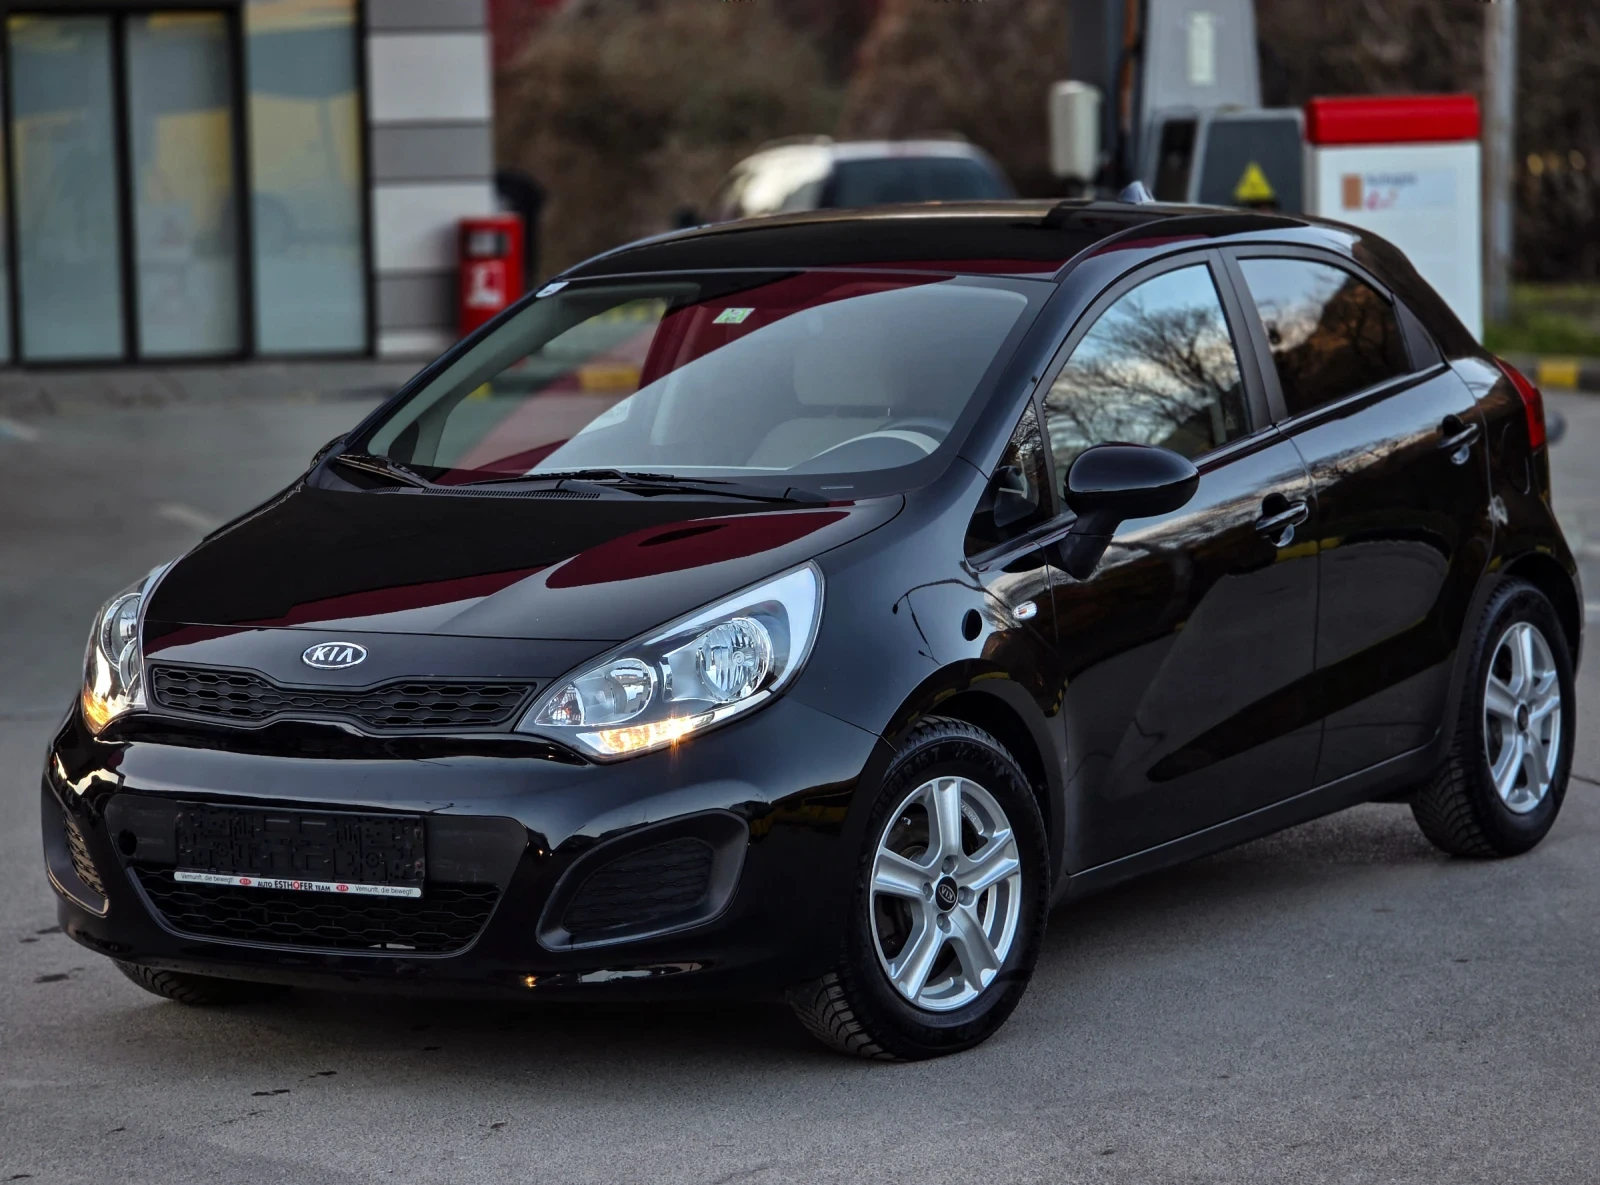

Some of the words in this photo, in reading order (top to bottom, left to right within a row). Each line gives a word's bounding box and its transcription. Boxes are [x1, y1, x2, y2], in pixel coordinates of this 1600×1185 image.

[311, 646, 354, 663] KIA
[931, 747, 940, 761] T
[180, 872, 204, 880] Vernunft,
[213, 876, 235, 887] bewegt!
[275, 880, 313, 891] ESTHOFER
[315, 884, 331, 892] TEAM
[354, 885, 380, 894] Vernunft,
[391, 887, 413, 896] bewegt!
